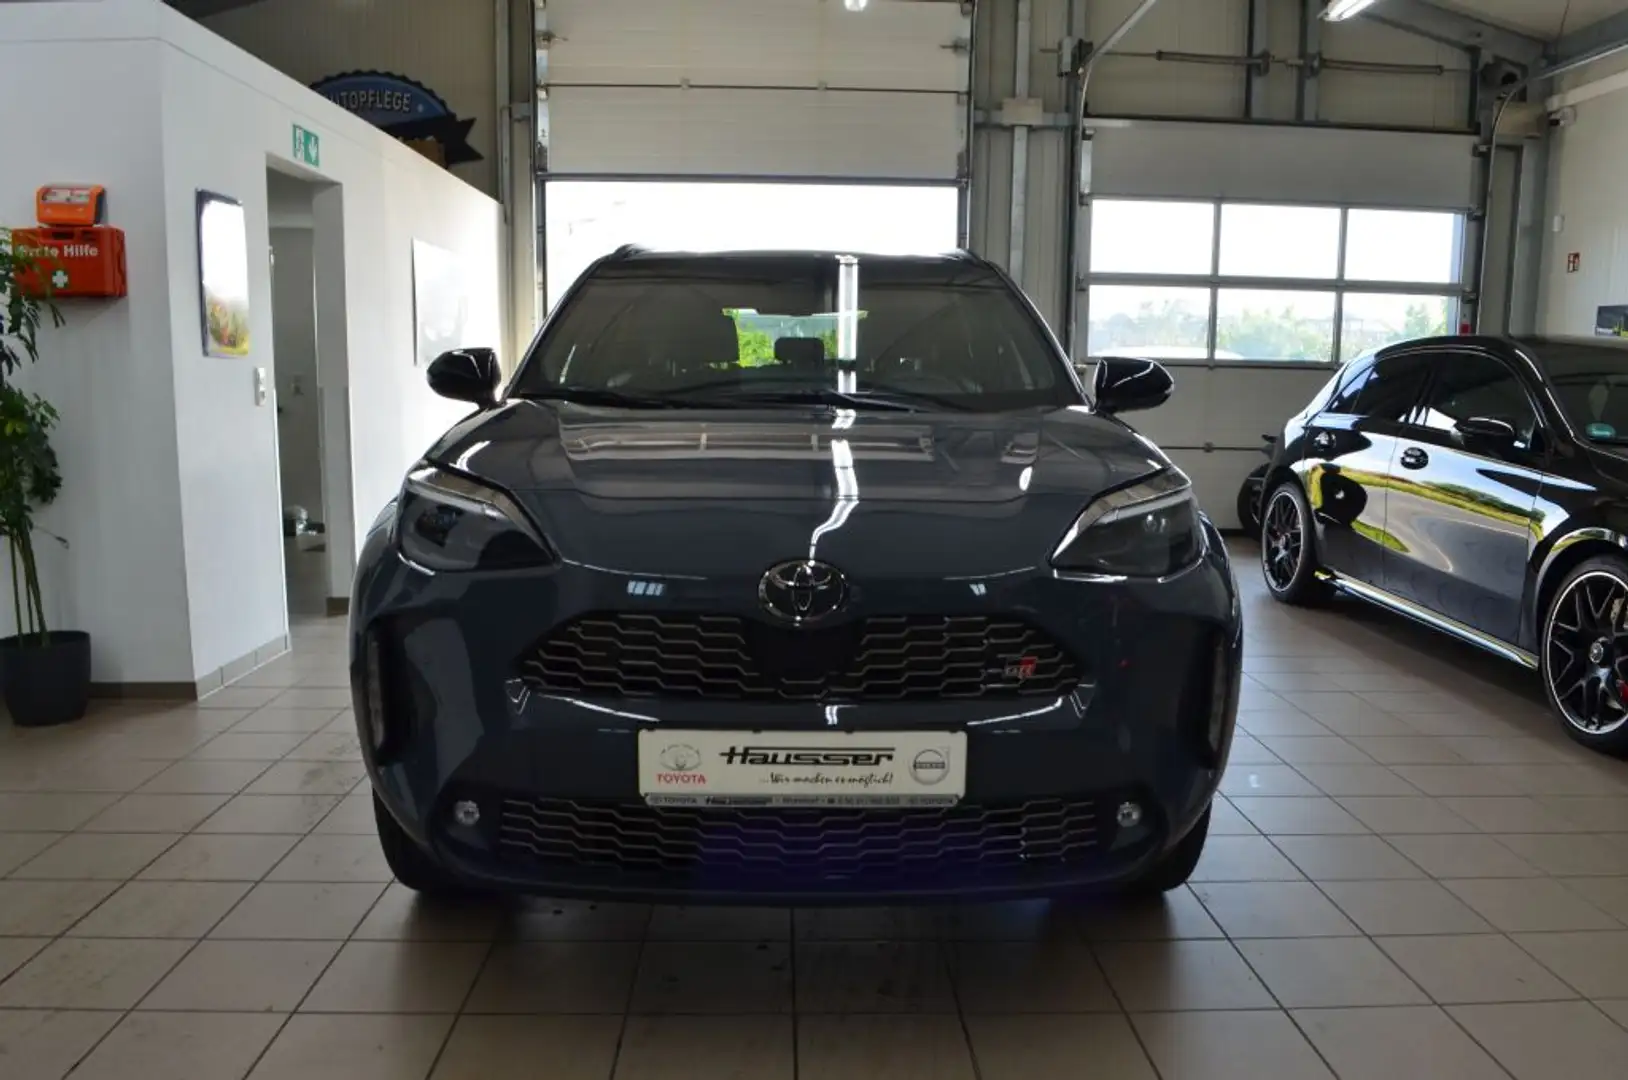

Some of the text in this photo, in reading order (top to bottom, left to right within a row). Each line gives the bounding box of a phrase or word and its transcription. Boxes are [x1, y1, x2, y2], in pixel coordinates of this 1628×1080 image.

[327, 89, 411, 111] UTOPFLEGE
[63, 245, 98, 257] Hilfe
[719, 746, 895, 765] Hausser
[657, 773, 706, 784] TOYOTA
